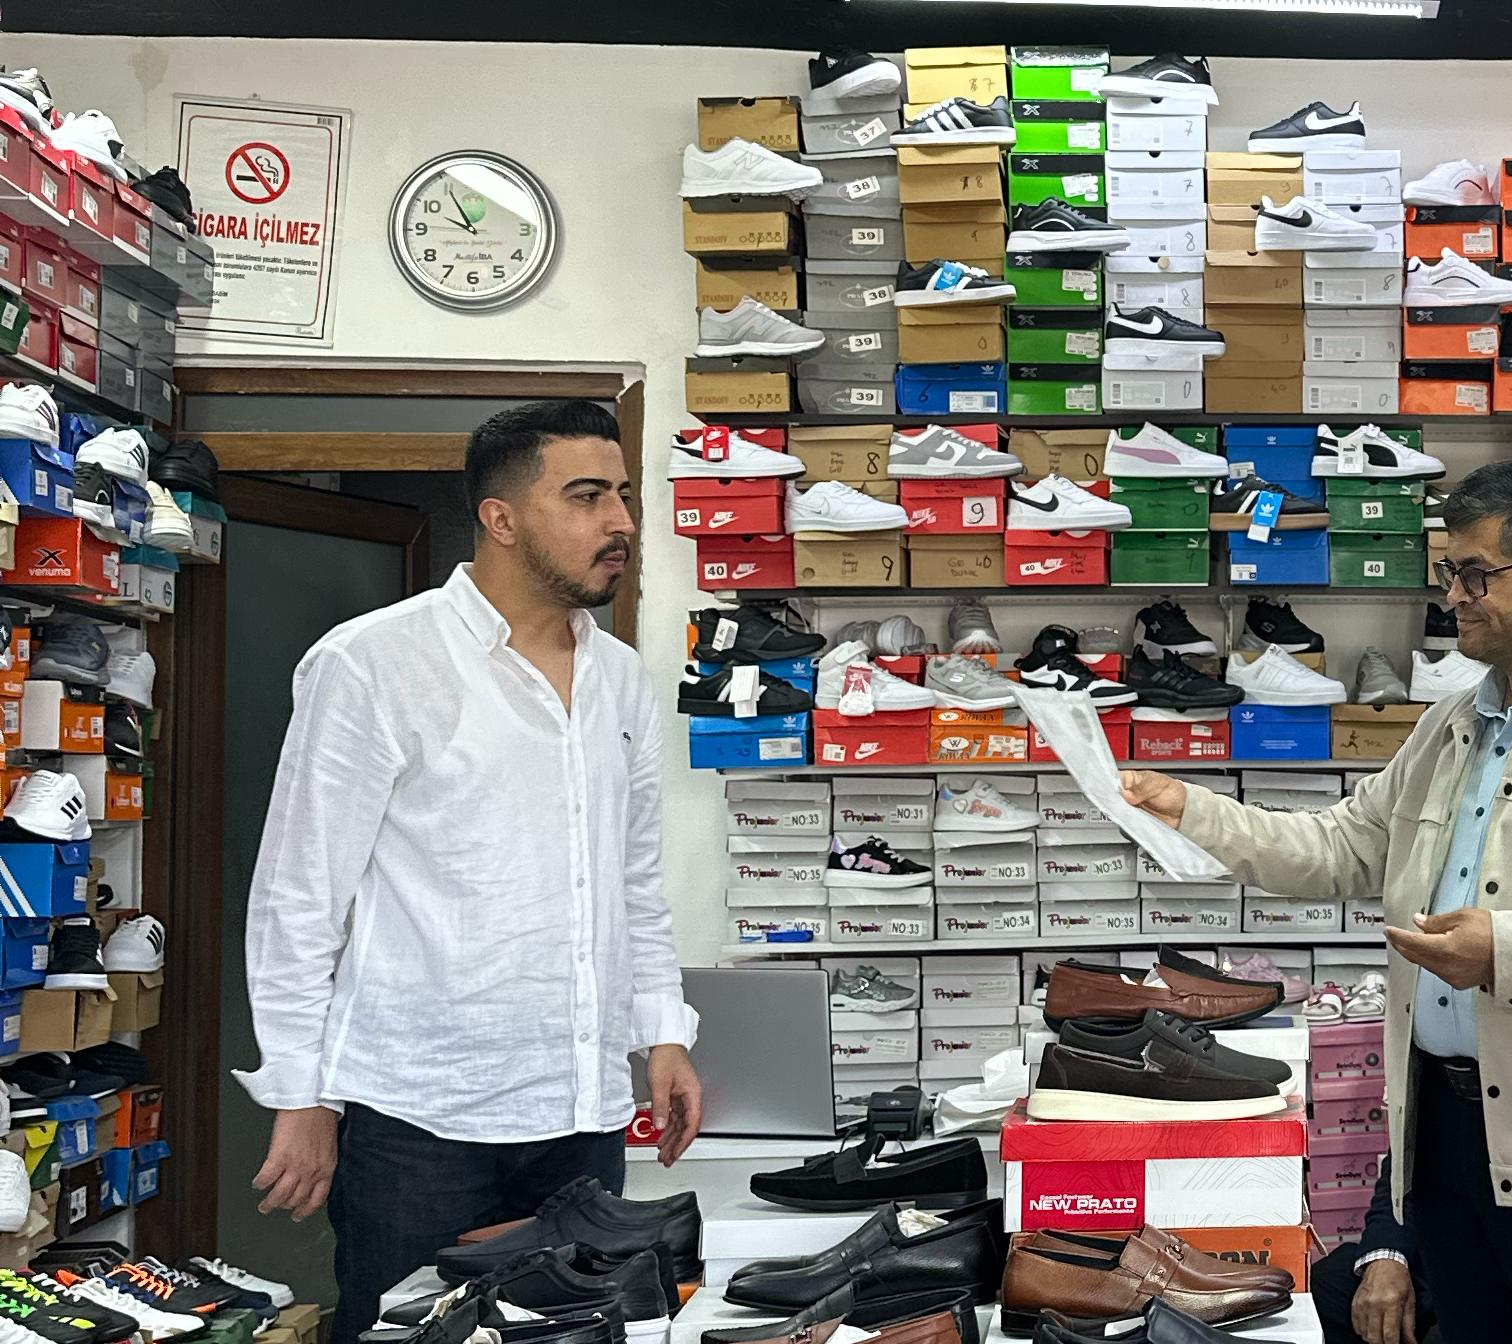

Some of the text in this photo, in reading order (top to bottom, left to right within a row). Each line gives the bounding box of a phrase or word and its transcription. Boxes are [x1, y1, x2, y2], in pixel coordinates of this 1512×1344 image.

[859, 125, 877, 141] 37
[852, 180, 871, 193] 38
[424, 200, 441, 213] 10
[254, 212, 320, 247] İÇİLMEZ
[415, 223, 427, 235] 9
[519, 223, 531, 236] 3
[858, 231, 876, 241] 39
[423, 249, 437, 262] 8
[511, 249, 524, 261] 4
[442, 265, 454, 278] 7
[493, 265, 505, 278] 5
[467, 272, 479, 285] 6
[868, 289, 887, 300] 38
[854, 336, 873, 347] 39
[855, 391, 875, 402] 39
[866, 452, 880, 475] 8
[971, 502, 986, 524] 9
[1365, 505, 1379, 516] 39
[679, 512, 698, 524] 39
[707, 565, 725, 577] 40
[882, 556, 894, 581] 9
[1368, 564, 1381, 575] 40
[897, 806, 923, 820] NO:31
[791, 814, 820, 826] NO:33
[999, 866, 1025, 878] NO:33
[1094, 858, 1123, 873] NO:33
[793, 868, 821, 881] NO:35
[1201, 913, 1228, 926] NO:34
[1306, 908, 1333, 920] NO:35
[1003, 914, 1030, 928] NO:34
[1107, 917, 1135, 928] NO:35
[892, 921, 919, 935] NO:33
[1030, 1198, 1137, 1210] NEW PRATO
